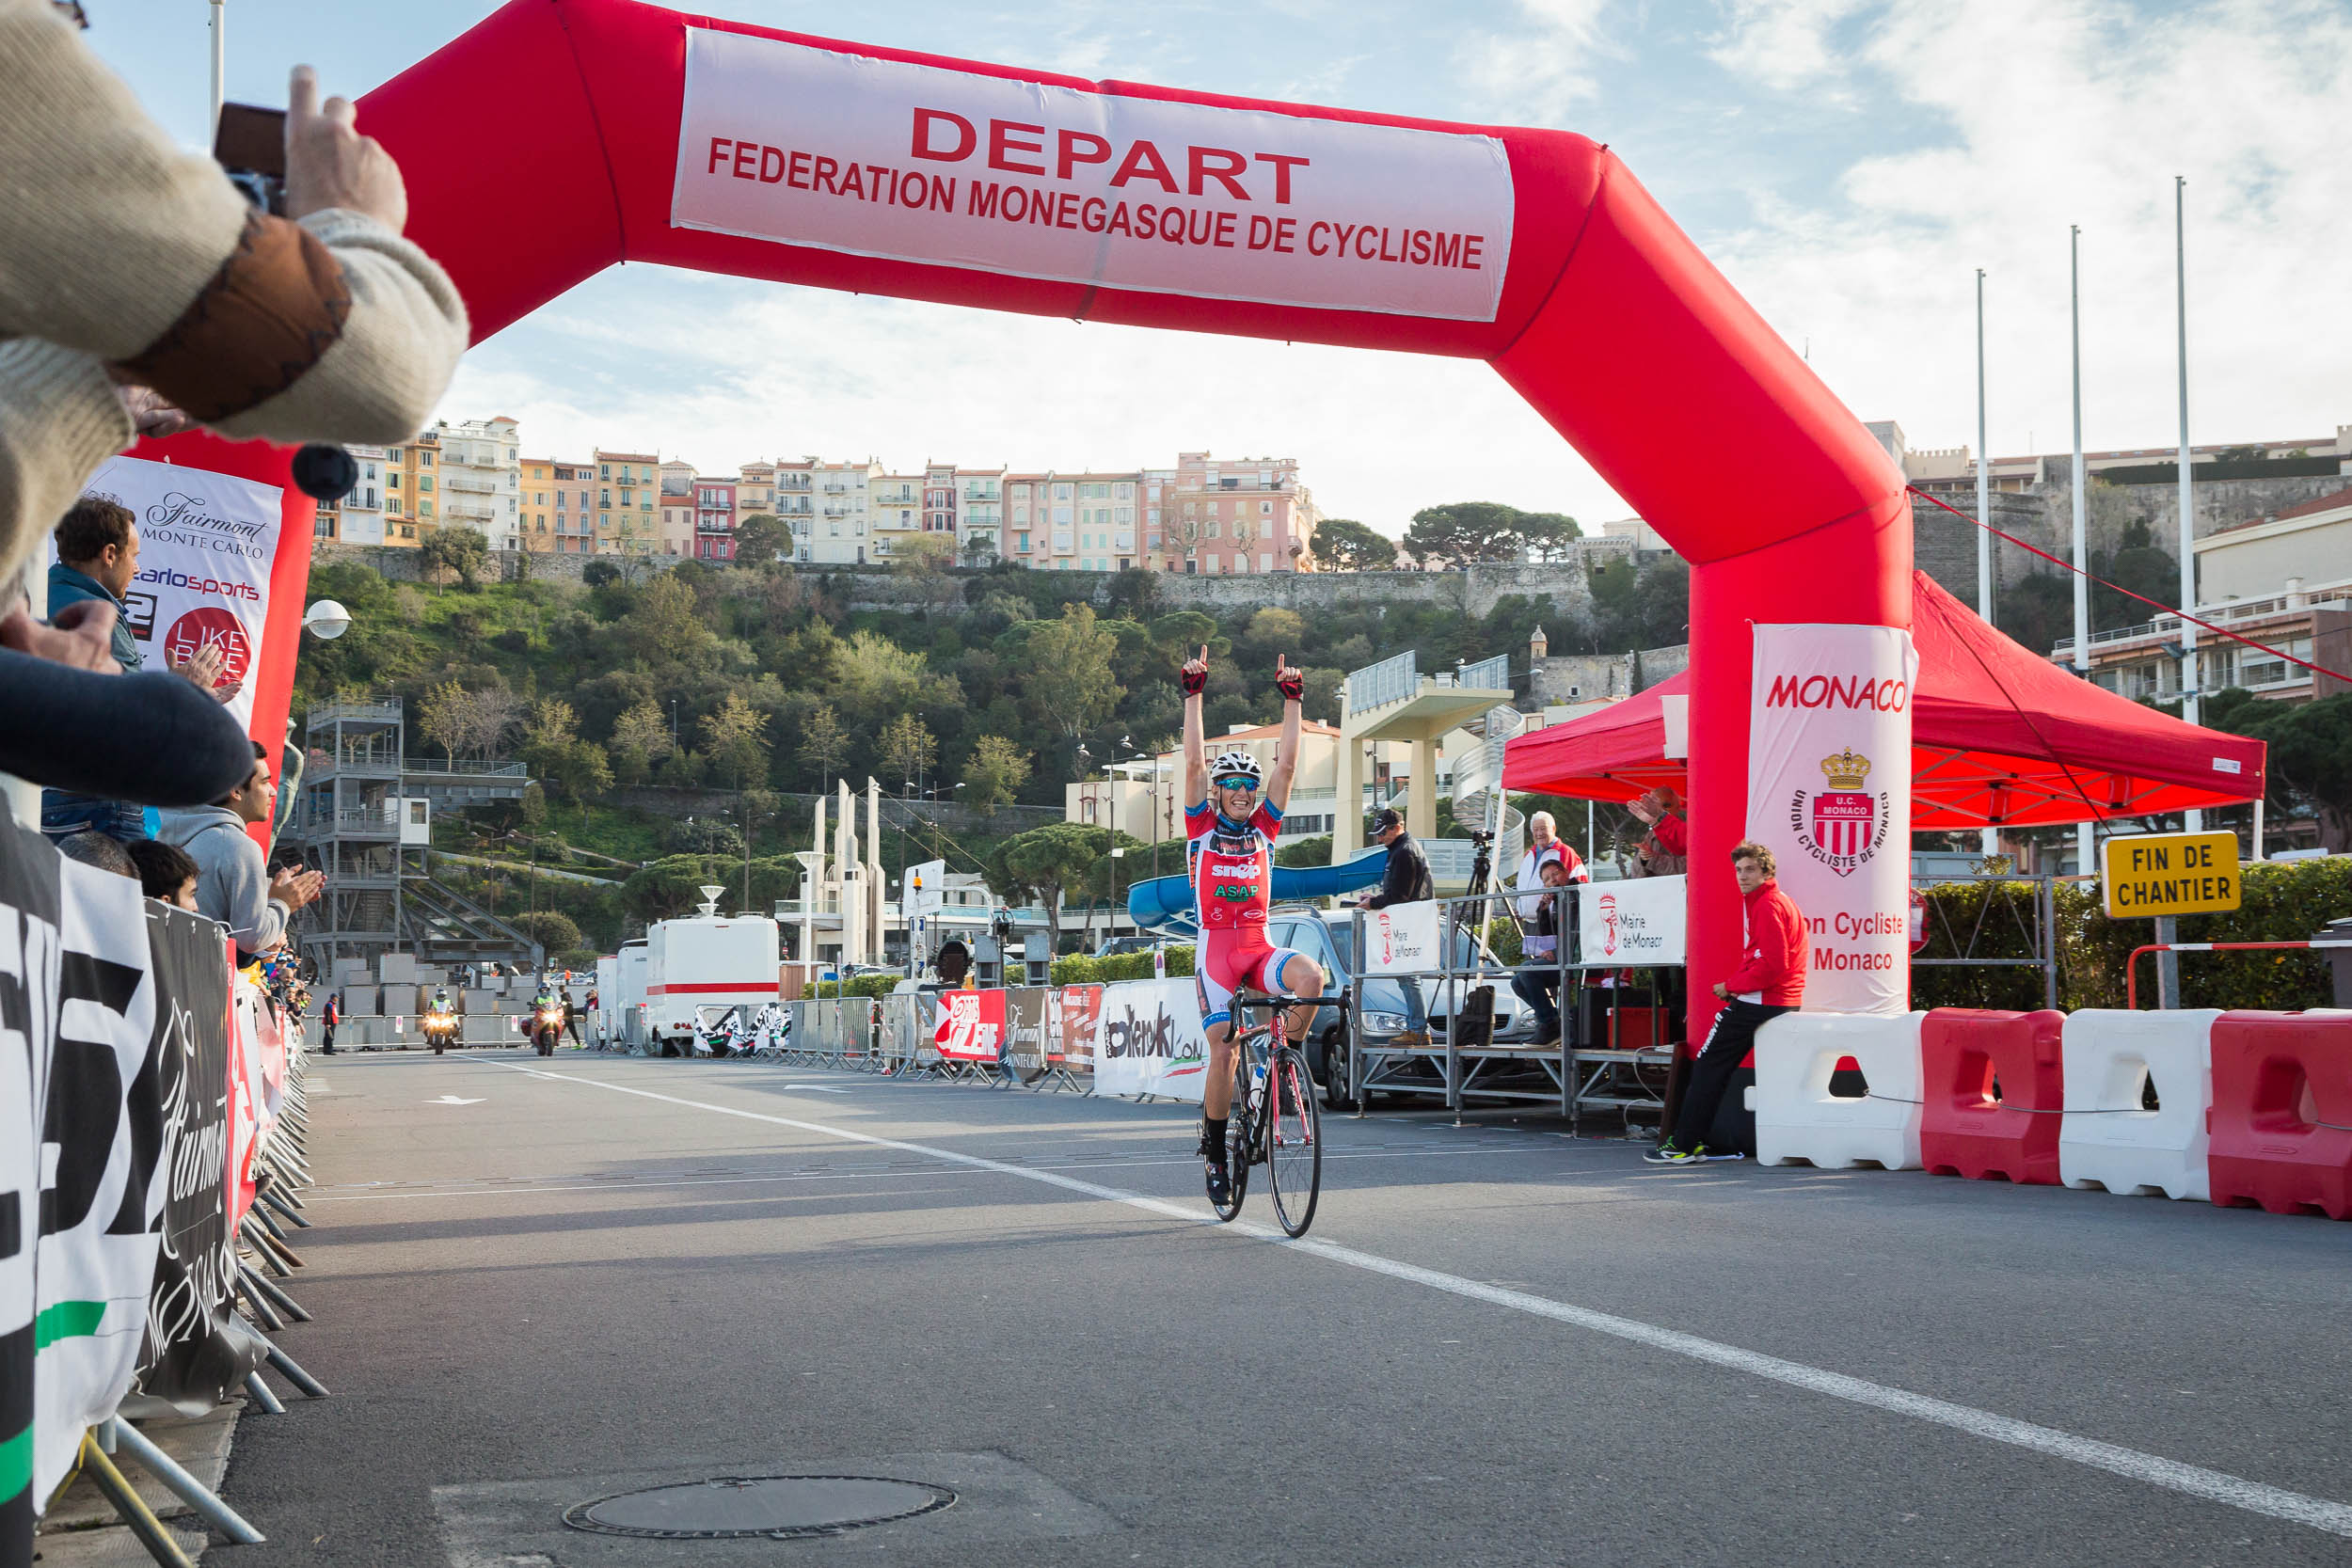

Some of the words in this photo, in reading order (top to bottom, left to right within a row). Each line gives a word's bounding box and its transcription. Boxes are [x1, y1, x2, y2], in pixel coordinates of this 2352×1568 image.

[910, 106, 1311, 205] DEPART
[707, 136, 956, 214] FEDERATION
[968, 180, 1237, 248] MONEGASQUE
[1248, 215, 1297, 253] DE
[1307, 220, 1485, 271] CYCLISME
[146, 491, 270, 543] Fairmont
[142, 528, 208, 548] MONTE
[213, 542, 263, 559] CARLO
[176, 622, 246, 651] LIKE
[175, 644, 244, 673] BE
[1766, 674, 1906, 713] MONACO
[1790, 789, 1807, 832] UNION
[1823, 806, 1867, 816] MONACO
[1836, 797, 1857, 805] U.C.
[1875, 792, 1889, 849] MONACO
[1798, 833, 1857, 868] CYCLISTE
[1860, 849, 1875, 864] DE
[2132, 847, 2169, 872] FIN
[2185, 845, 2213, 868] DE
[1214, 885, 1259, 897] ASAP
[2118, 877, 2231, 906] CHANTIER
[1619, 912, 1645, 929] Mairie
[1804, 916, 1826, 935] on
[1835, 911, 1903, 941] Cycliste
[1623, 933, 1631, 948] de
[1632, 933, 1663, 948] Monaco
[1814, 947, 1892, 971] Monaco
